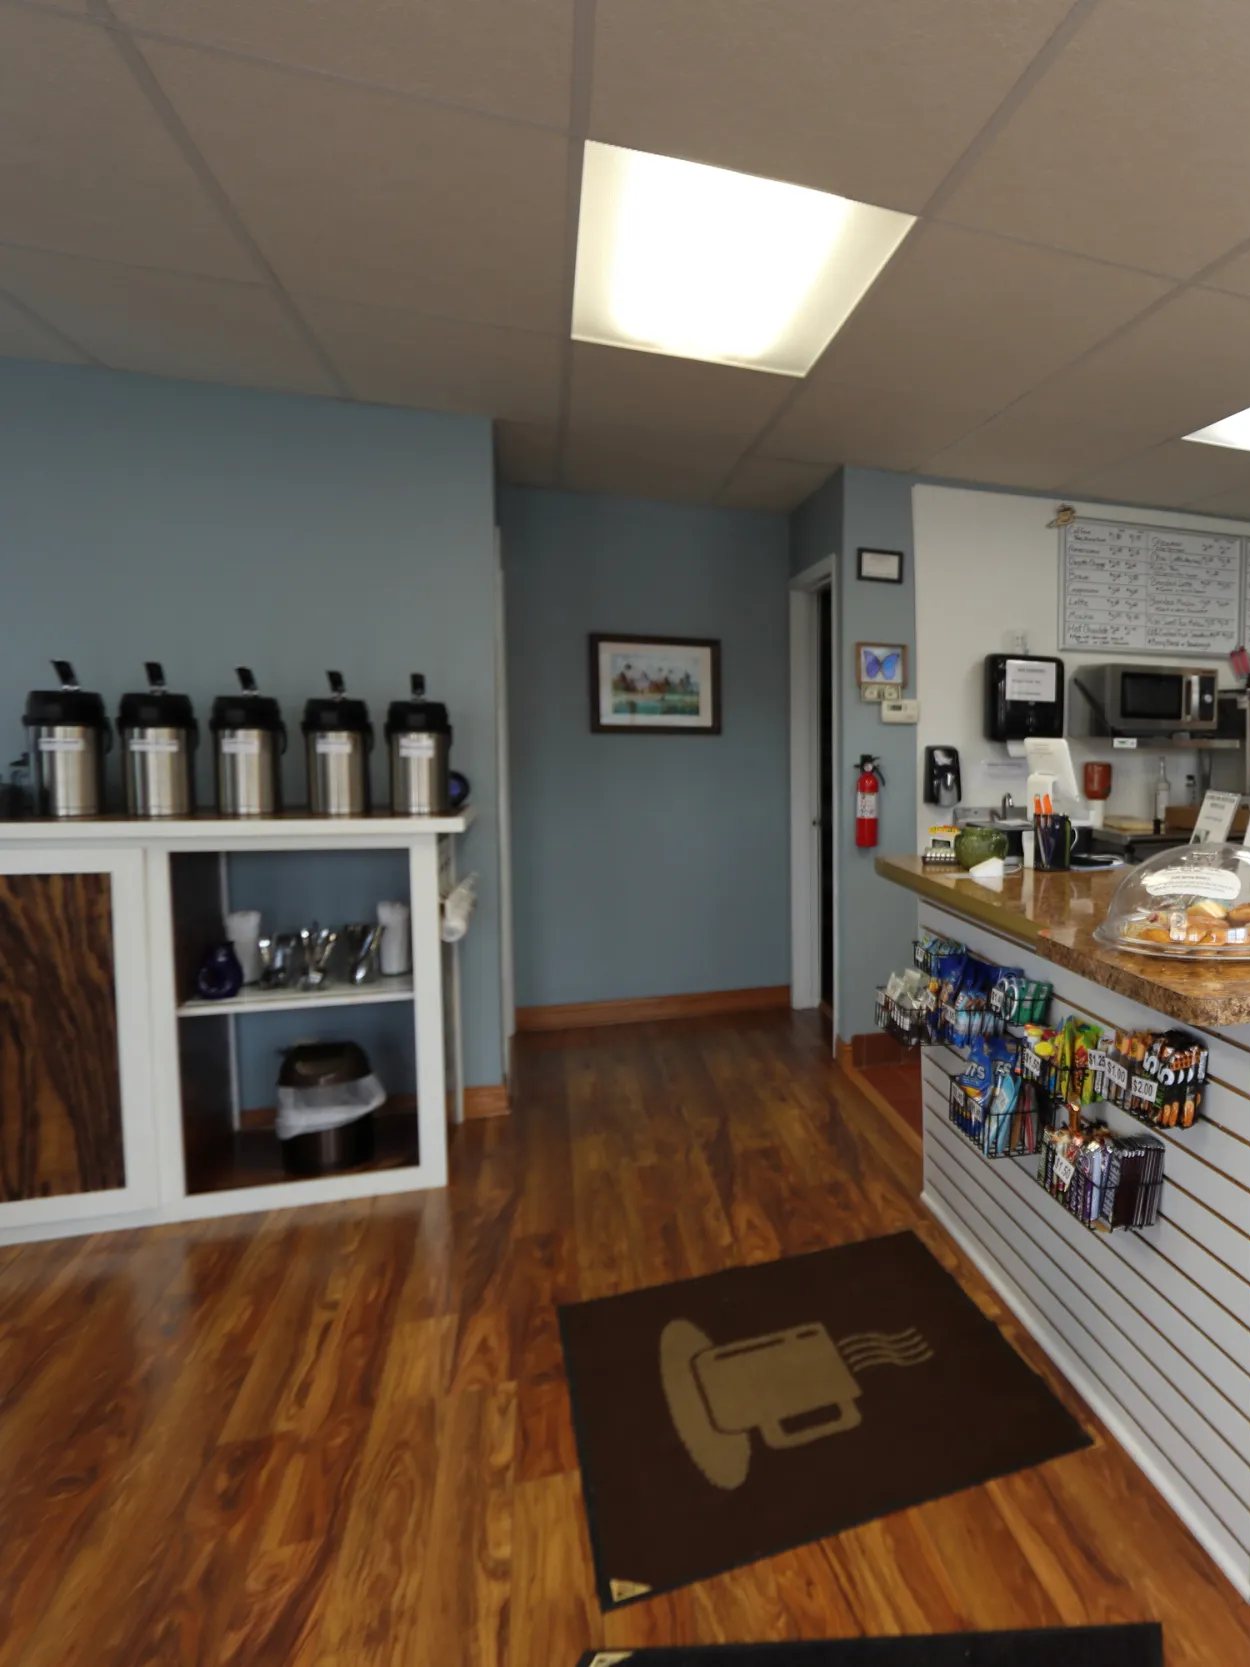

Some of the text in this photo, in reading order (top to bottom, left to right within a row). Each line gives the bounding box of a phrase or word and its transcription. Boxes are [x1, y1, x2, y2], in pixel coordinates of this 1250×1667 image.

[965, 1061, 986, 1080] ITS
[1107, 1060, 1126, 1083] $1.00
[1132, 1079, 1154, 1097] $2.00
[1055, 1157, 1072, 1180] $1.50
